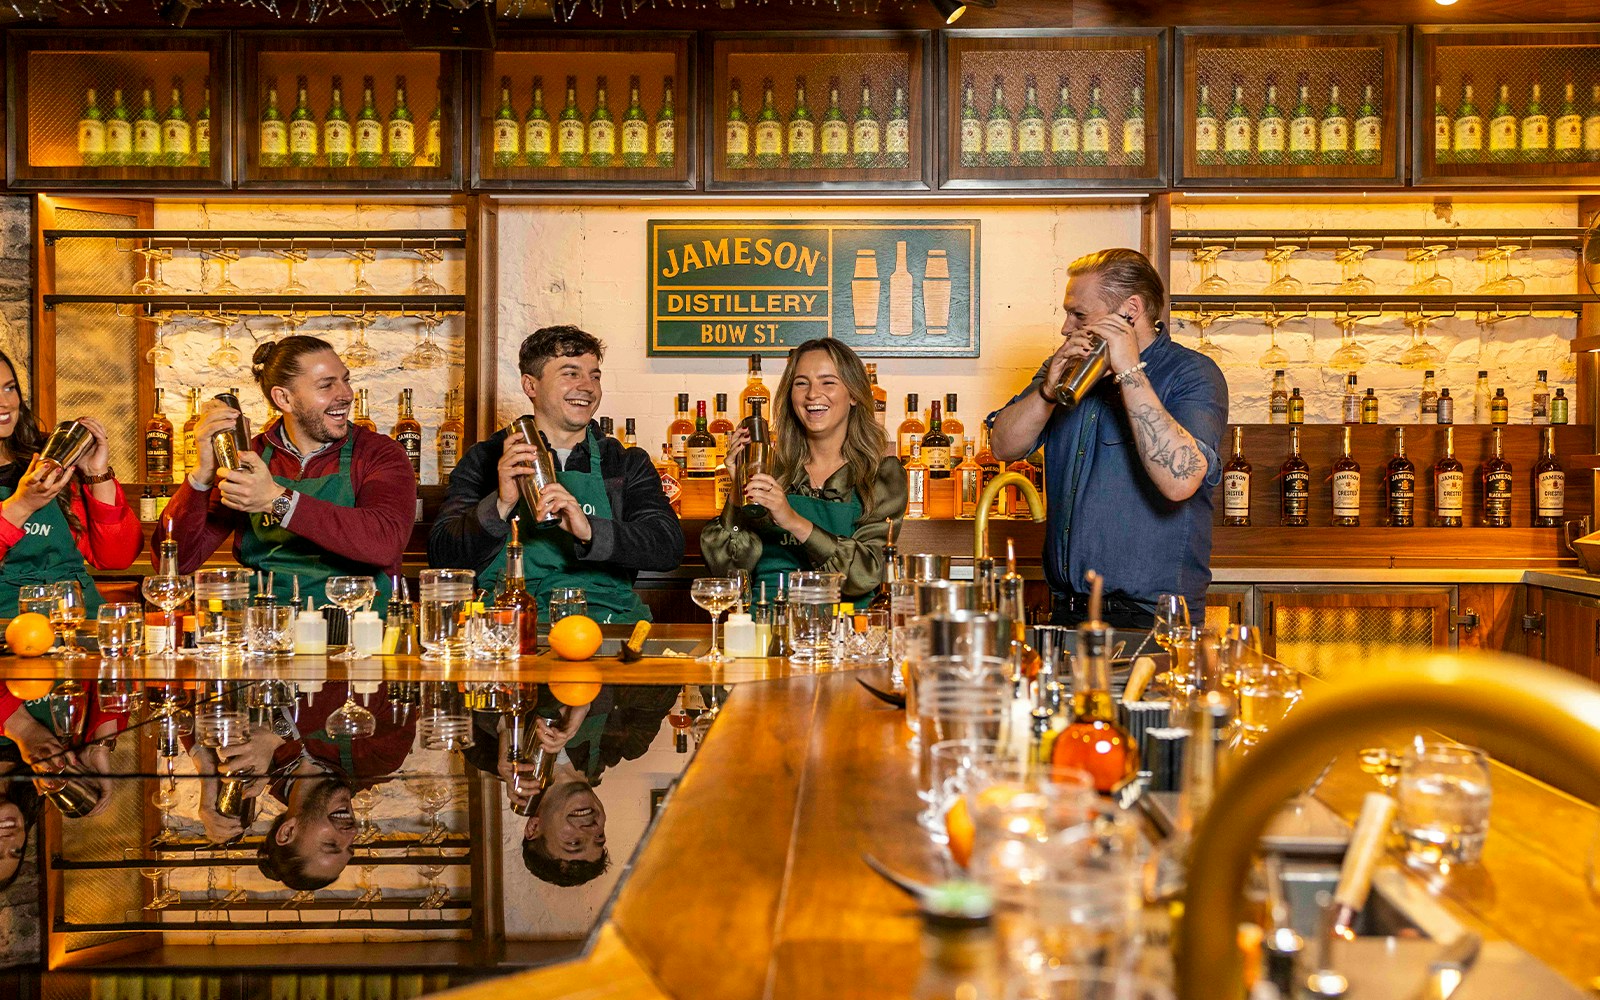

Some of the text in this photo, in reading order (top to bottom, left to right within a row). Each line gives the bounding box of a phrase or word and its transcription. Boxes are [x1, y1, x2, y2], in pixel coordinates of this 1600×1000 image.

[662, 237, 821, 278] JAMESON
[668, 294, 817, 313] DISTILLERY
[702, 323, 783, 344] BOW ST.
